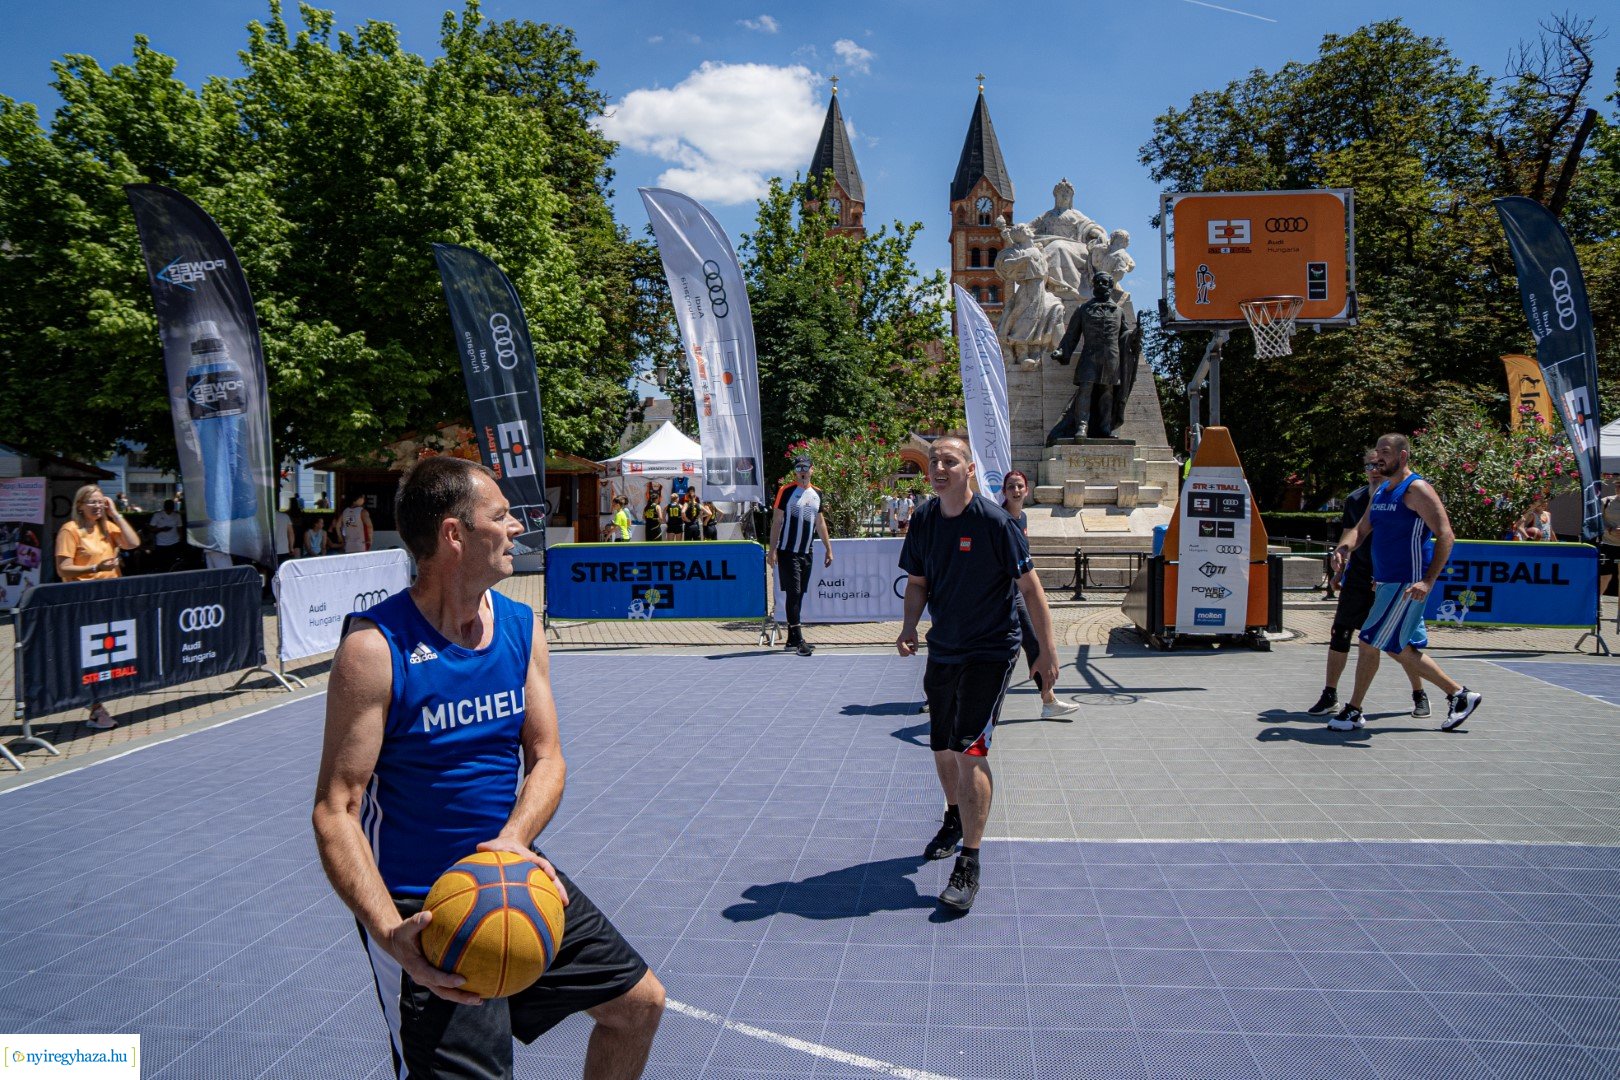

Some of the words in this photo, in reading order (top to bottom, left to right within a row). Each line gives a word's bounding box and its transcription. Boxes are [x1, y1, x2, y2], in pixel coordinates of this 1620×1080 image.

[1267, 246, 1300, 254] Hungaria
[1069, 456, 1126, 468] KOSSUTH
[817, 578, 845, 588] Audi
[818, 590, 871, 601] Hungaria
[308, 602, 327, 614] Audi
[308, 613, 341, 628] Hungaria
[181, 640, 203, 653] Audi
[181, 650, 217, 664] Hungaria
[409, 651, 438, 665] adidas
